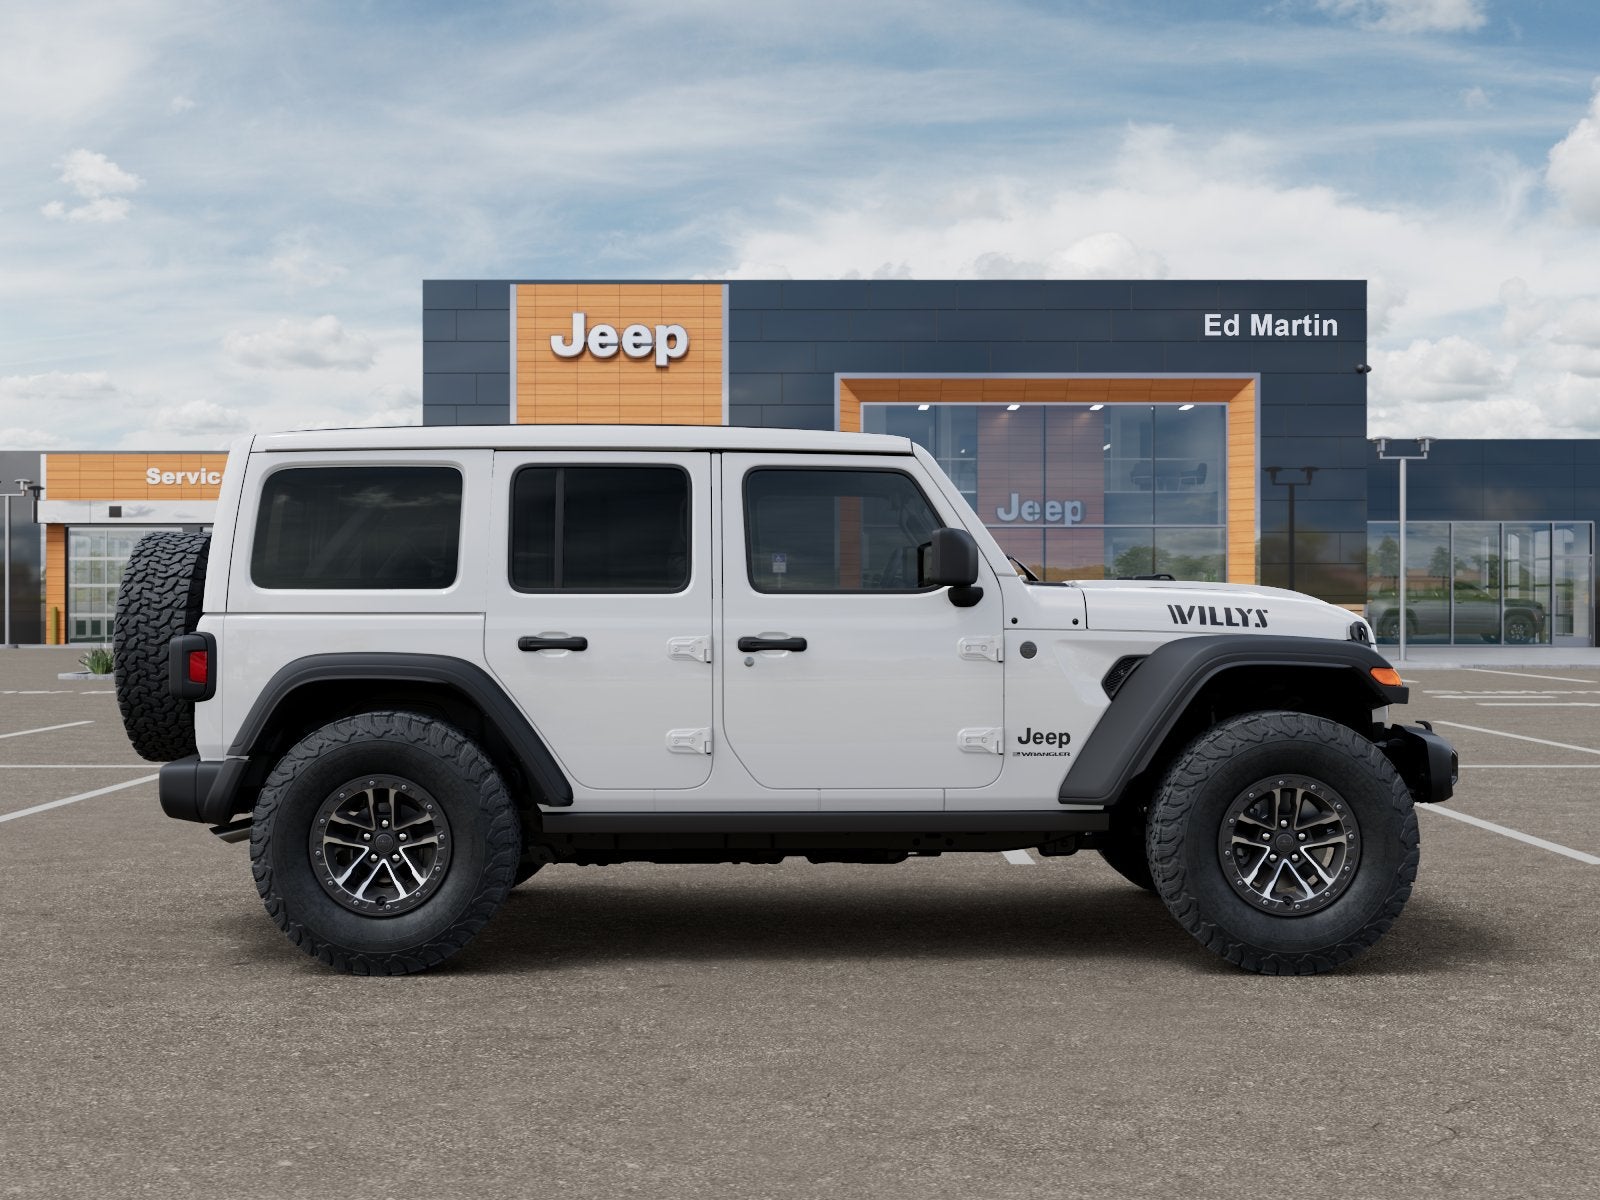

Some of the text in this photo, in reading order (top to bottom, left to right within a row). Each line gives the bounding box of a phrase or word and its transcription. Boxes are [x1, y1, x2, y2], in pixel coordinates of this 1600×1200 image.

[1204, 313, 1338, 337] Ed Martin
[550, 312, 689, 368] Jeep
[146, 467, 223, 485] Servic
[996, 493, 1083, 526] Jeep
[1167, 604, 1269, 628] WILLYS
[1017, 727, 1071, 748] Jeep
